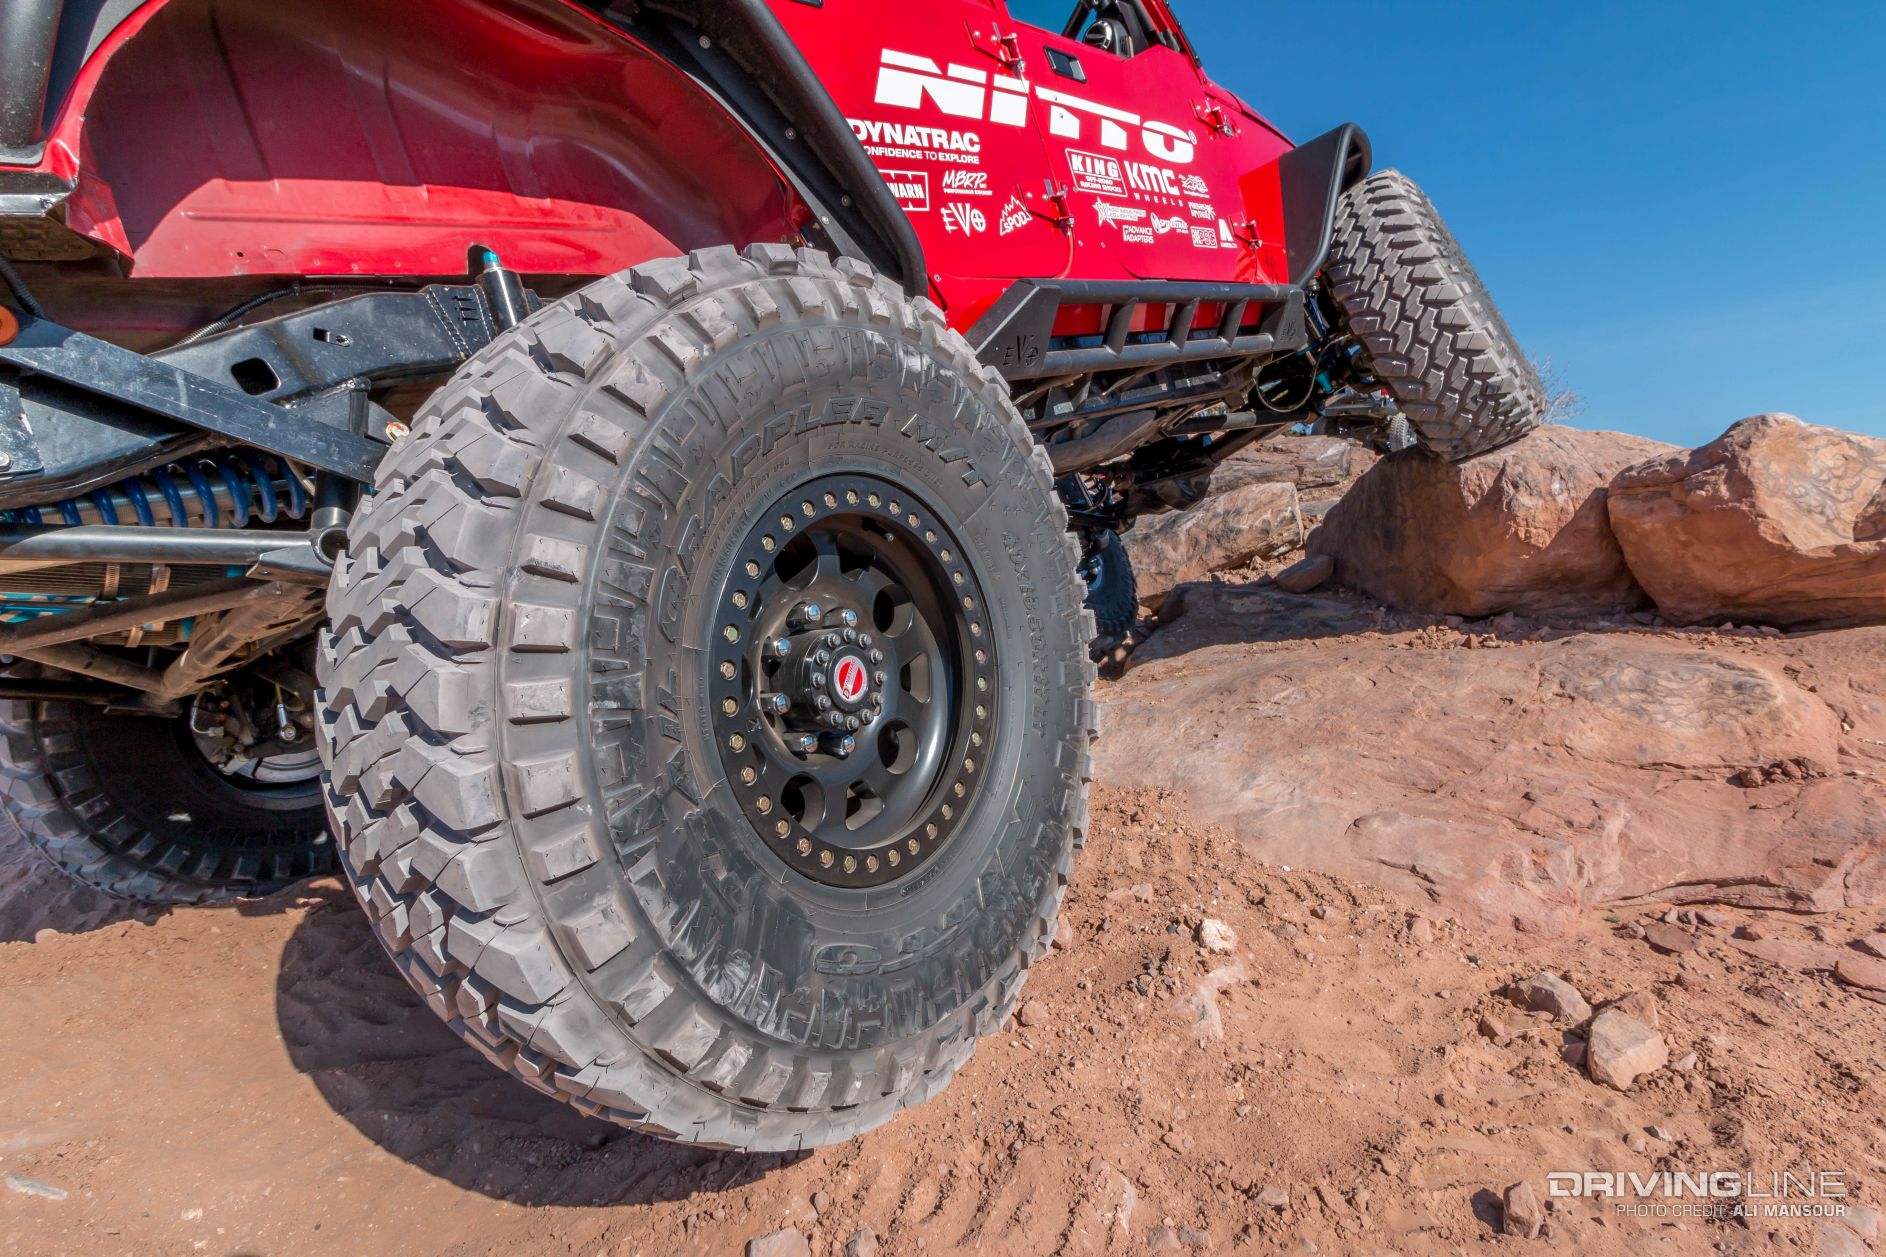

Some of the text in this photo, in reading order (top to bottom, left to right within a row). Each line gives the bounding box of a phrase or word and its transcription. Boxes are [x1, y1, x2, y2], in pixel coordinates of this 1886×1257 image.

[874, 47, 1194, 164] NITTO
[846, 118, 981, 153] DYNATRAC
[863, 145, 980, 165] ONFIDENCE TO EXPLORE
[1071, 153, 1119, 178] KING
[942, 169, 988, 189] MBRP
[1079, 180, 1103, 190] RACING
[1123, 160, 1181, 196] KMC
[886, 182, 926, 199] WARN
[1133, 192, 1184, 207] WHEELS
[940, 202, 986, 237] EVO
[1126, 234, 1154, 244] ADAPTERS
[1129, 225, 1153, 235] ADVANCE
